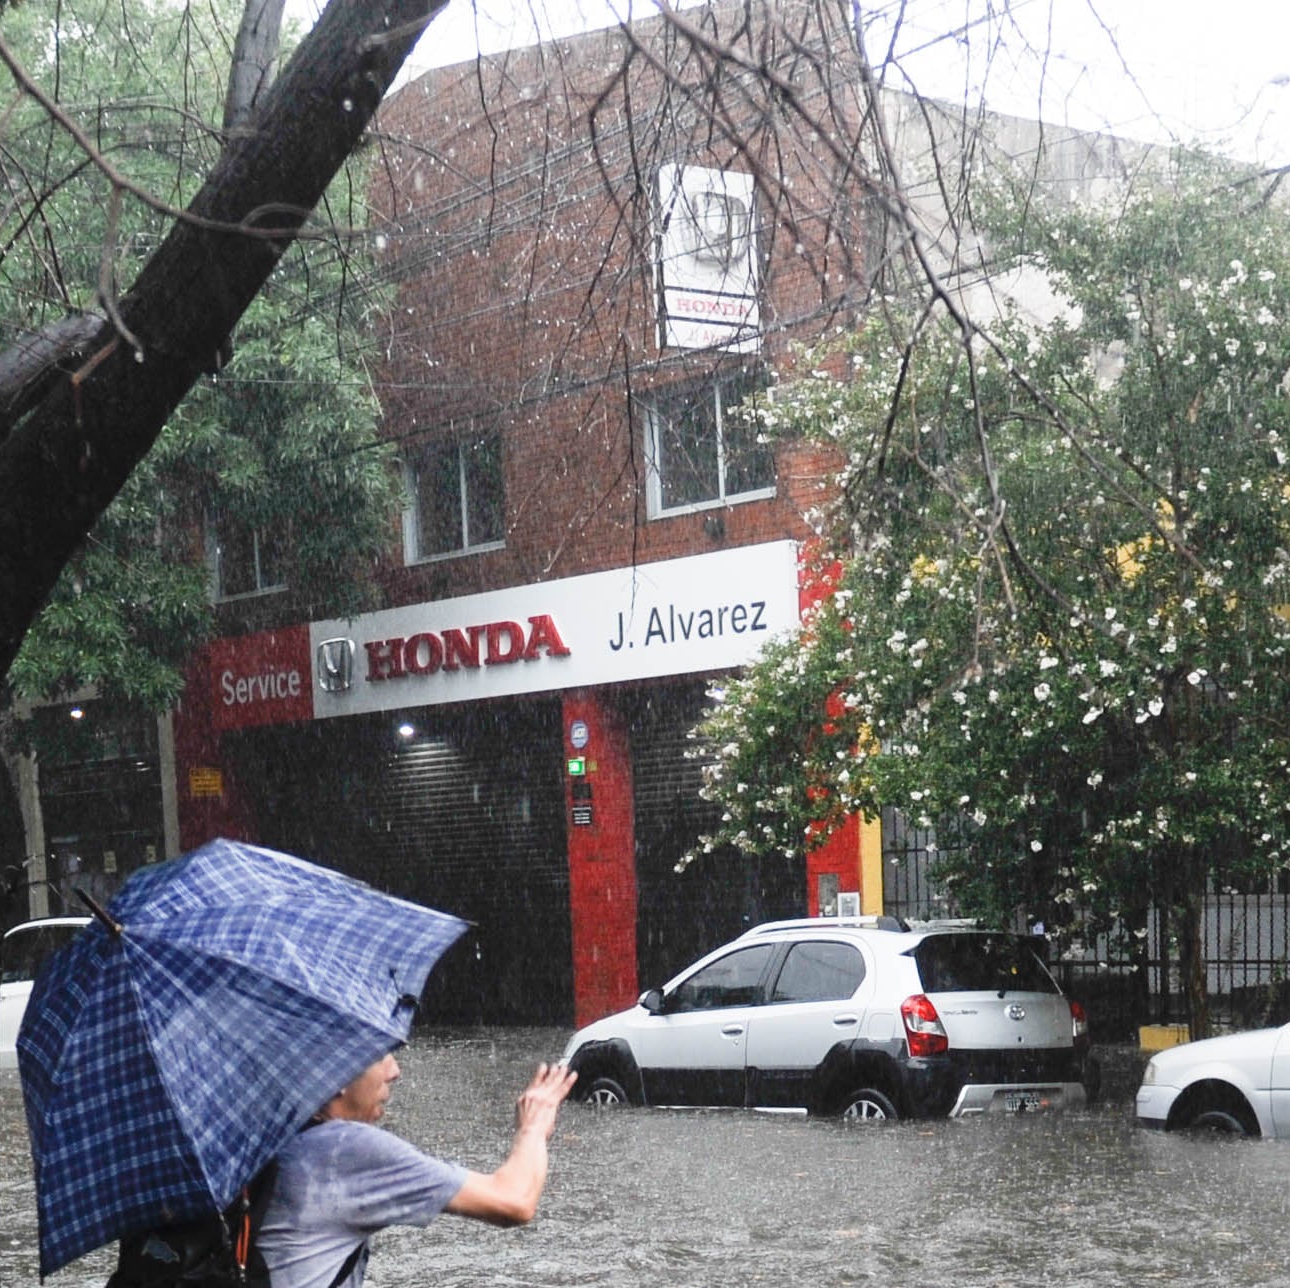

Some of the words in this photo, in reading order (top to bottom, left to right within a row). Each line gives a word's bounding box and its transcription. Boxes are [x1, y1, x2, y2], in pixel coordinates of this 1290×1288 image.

[676, 298, 750, 316] HONDA
[363, 614, 571, 682] HONDA
[610, 618, 633, 652] J.
[645, 601, 768, 647] Alvarez
[220, 666, 301, 706] Service
